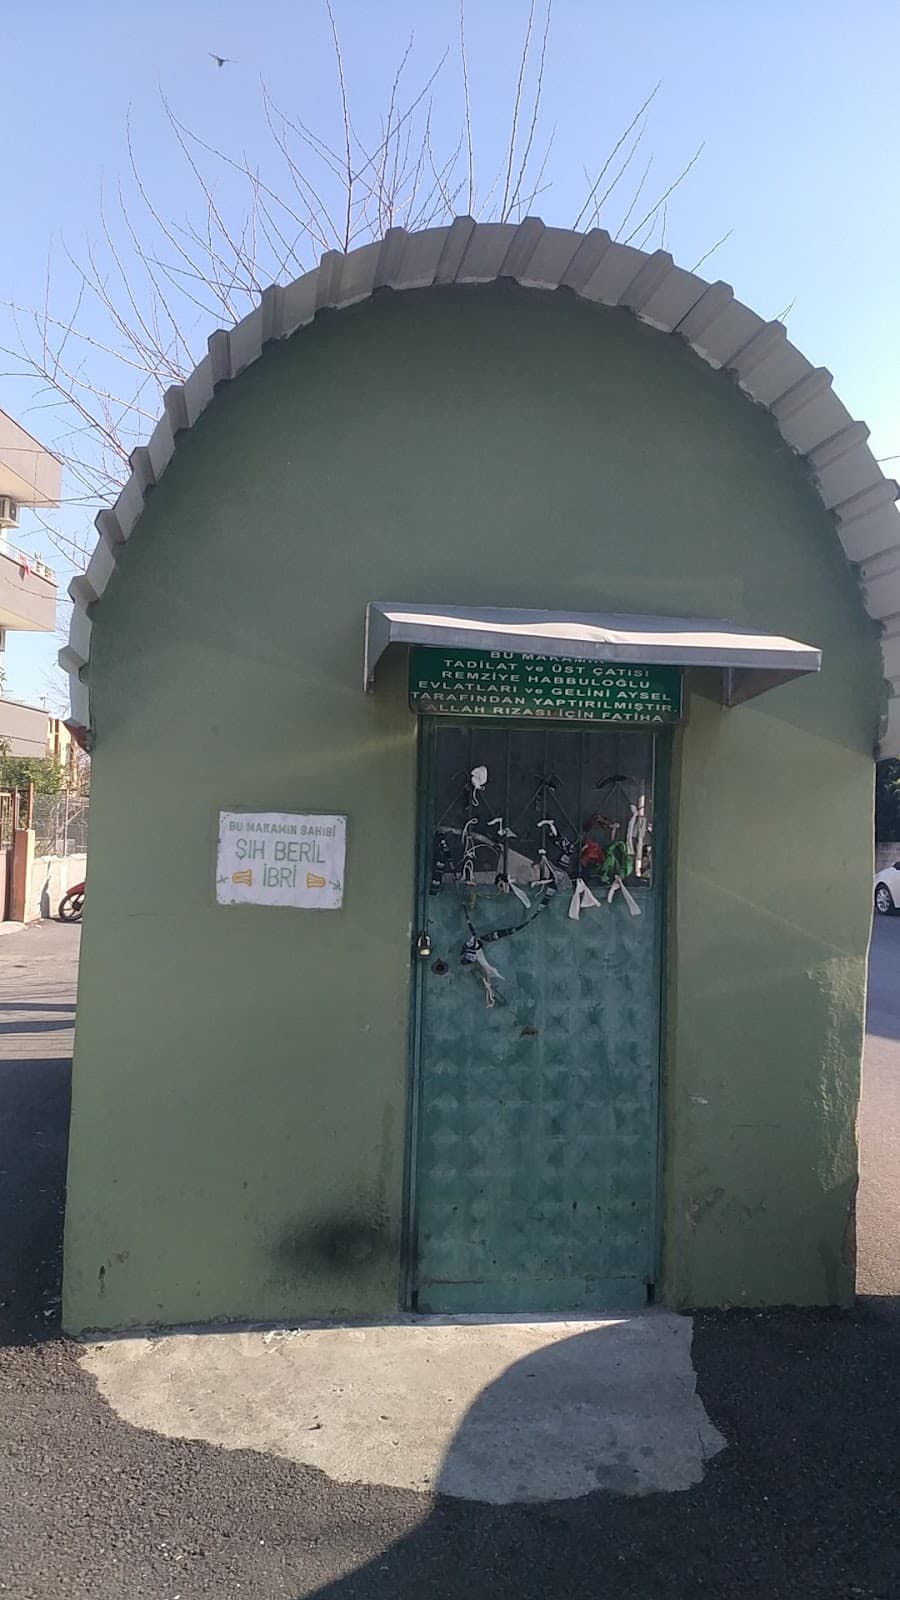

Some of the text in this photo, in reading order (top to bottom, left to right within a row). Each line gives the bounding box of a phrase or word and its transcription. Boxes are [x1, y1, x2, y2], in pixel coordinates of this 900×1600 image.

[490, 651, 514, 659] BU
[444, 660, 517, 670] TADİLAT
[552, 664, 585, 673] ÜST
[442, 671, 520, 682] REMZİYE
[410, 691, 525, 704] TARAFINDAN
[418, 681, 517, 693] EVLATLARI
[551, 687, 610, 698] GELİNİ
[617, 691, 671, 701] AYSEL
[426, 704, 485, 713] ALLAH
[493, 707, 553, 716] RIZASI
[560, 709, 594, 718] İÇİN
[229, 821, 243, 832] BU
[274, 840, 326, 863] BERİL
[263, 863, 296, 888] İBRİ
